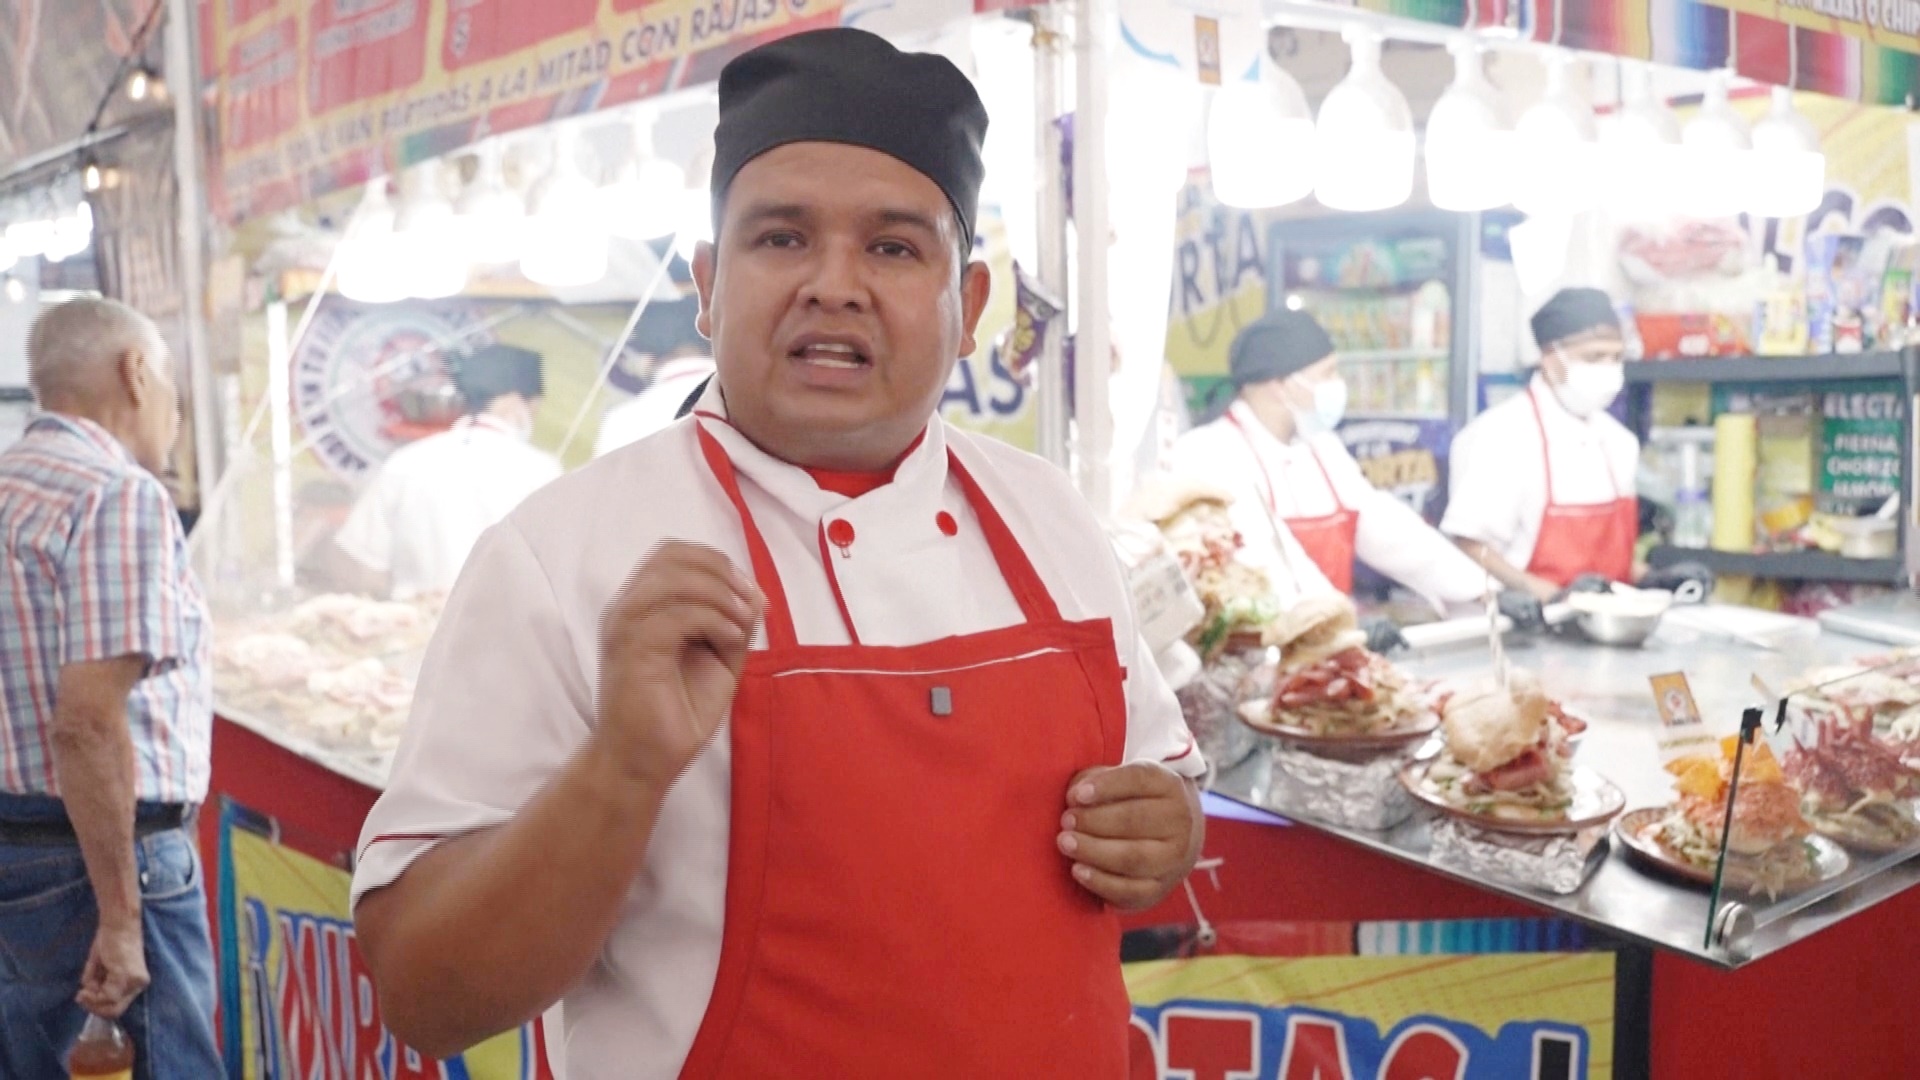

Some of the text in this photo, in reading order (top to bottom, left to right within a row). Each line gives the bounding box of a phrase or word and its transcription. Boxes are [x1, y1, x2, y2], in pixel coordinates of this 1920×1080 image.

[532, 40, 611, 88] MITAD
[620, 16, 682, 61] CON
[689, 0, 777, 42] RAJAS
